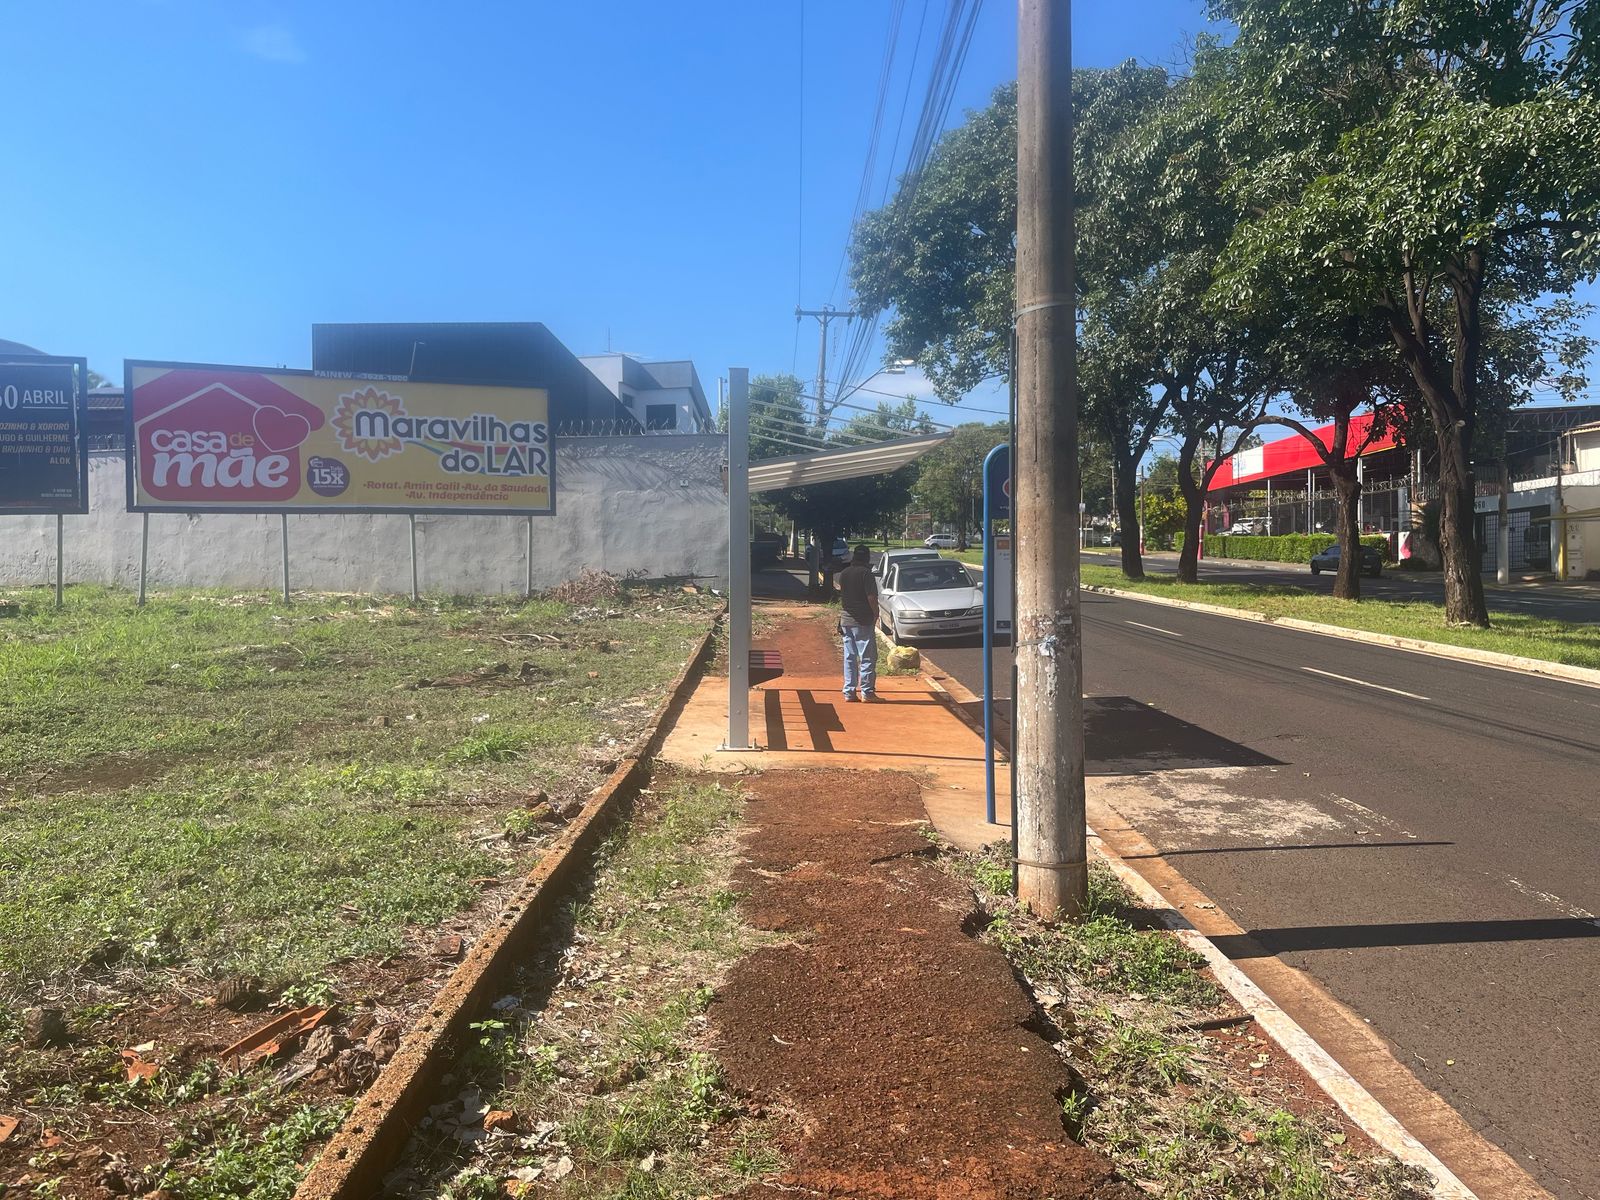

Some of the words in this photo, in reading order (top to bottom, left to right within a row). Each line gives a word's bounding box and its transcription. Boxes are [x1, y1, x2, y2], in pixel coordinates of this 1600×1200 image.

[23, 390, 68, 405] ABRIL
[355, 410, 548, 444] Maravilhas
[25, 434, 70, 443] GUILHERME
[151, 429, 228, 453] casa
[229, 432, 255, 447] de
[49, 457, 71, 465] ALOK
[441, 449, 480, 473] do
[487, 446, 548, 475] LAR
[153, 448, 290, 489] mãe
[403, 480, 433, 490] Amin
[484, 483, 498, 492] da
[500, 484, 548, 494] Saudade
[428, 491, 509, 501] Independência
